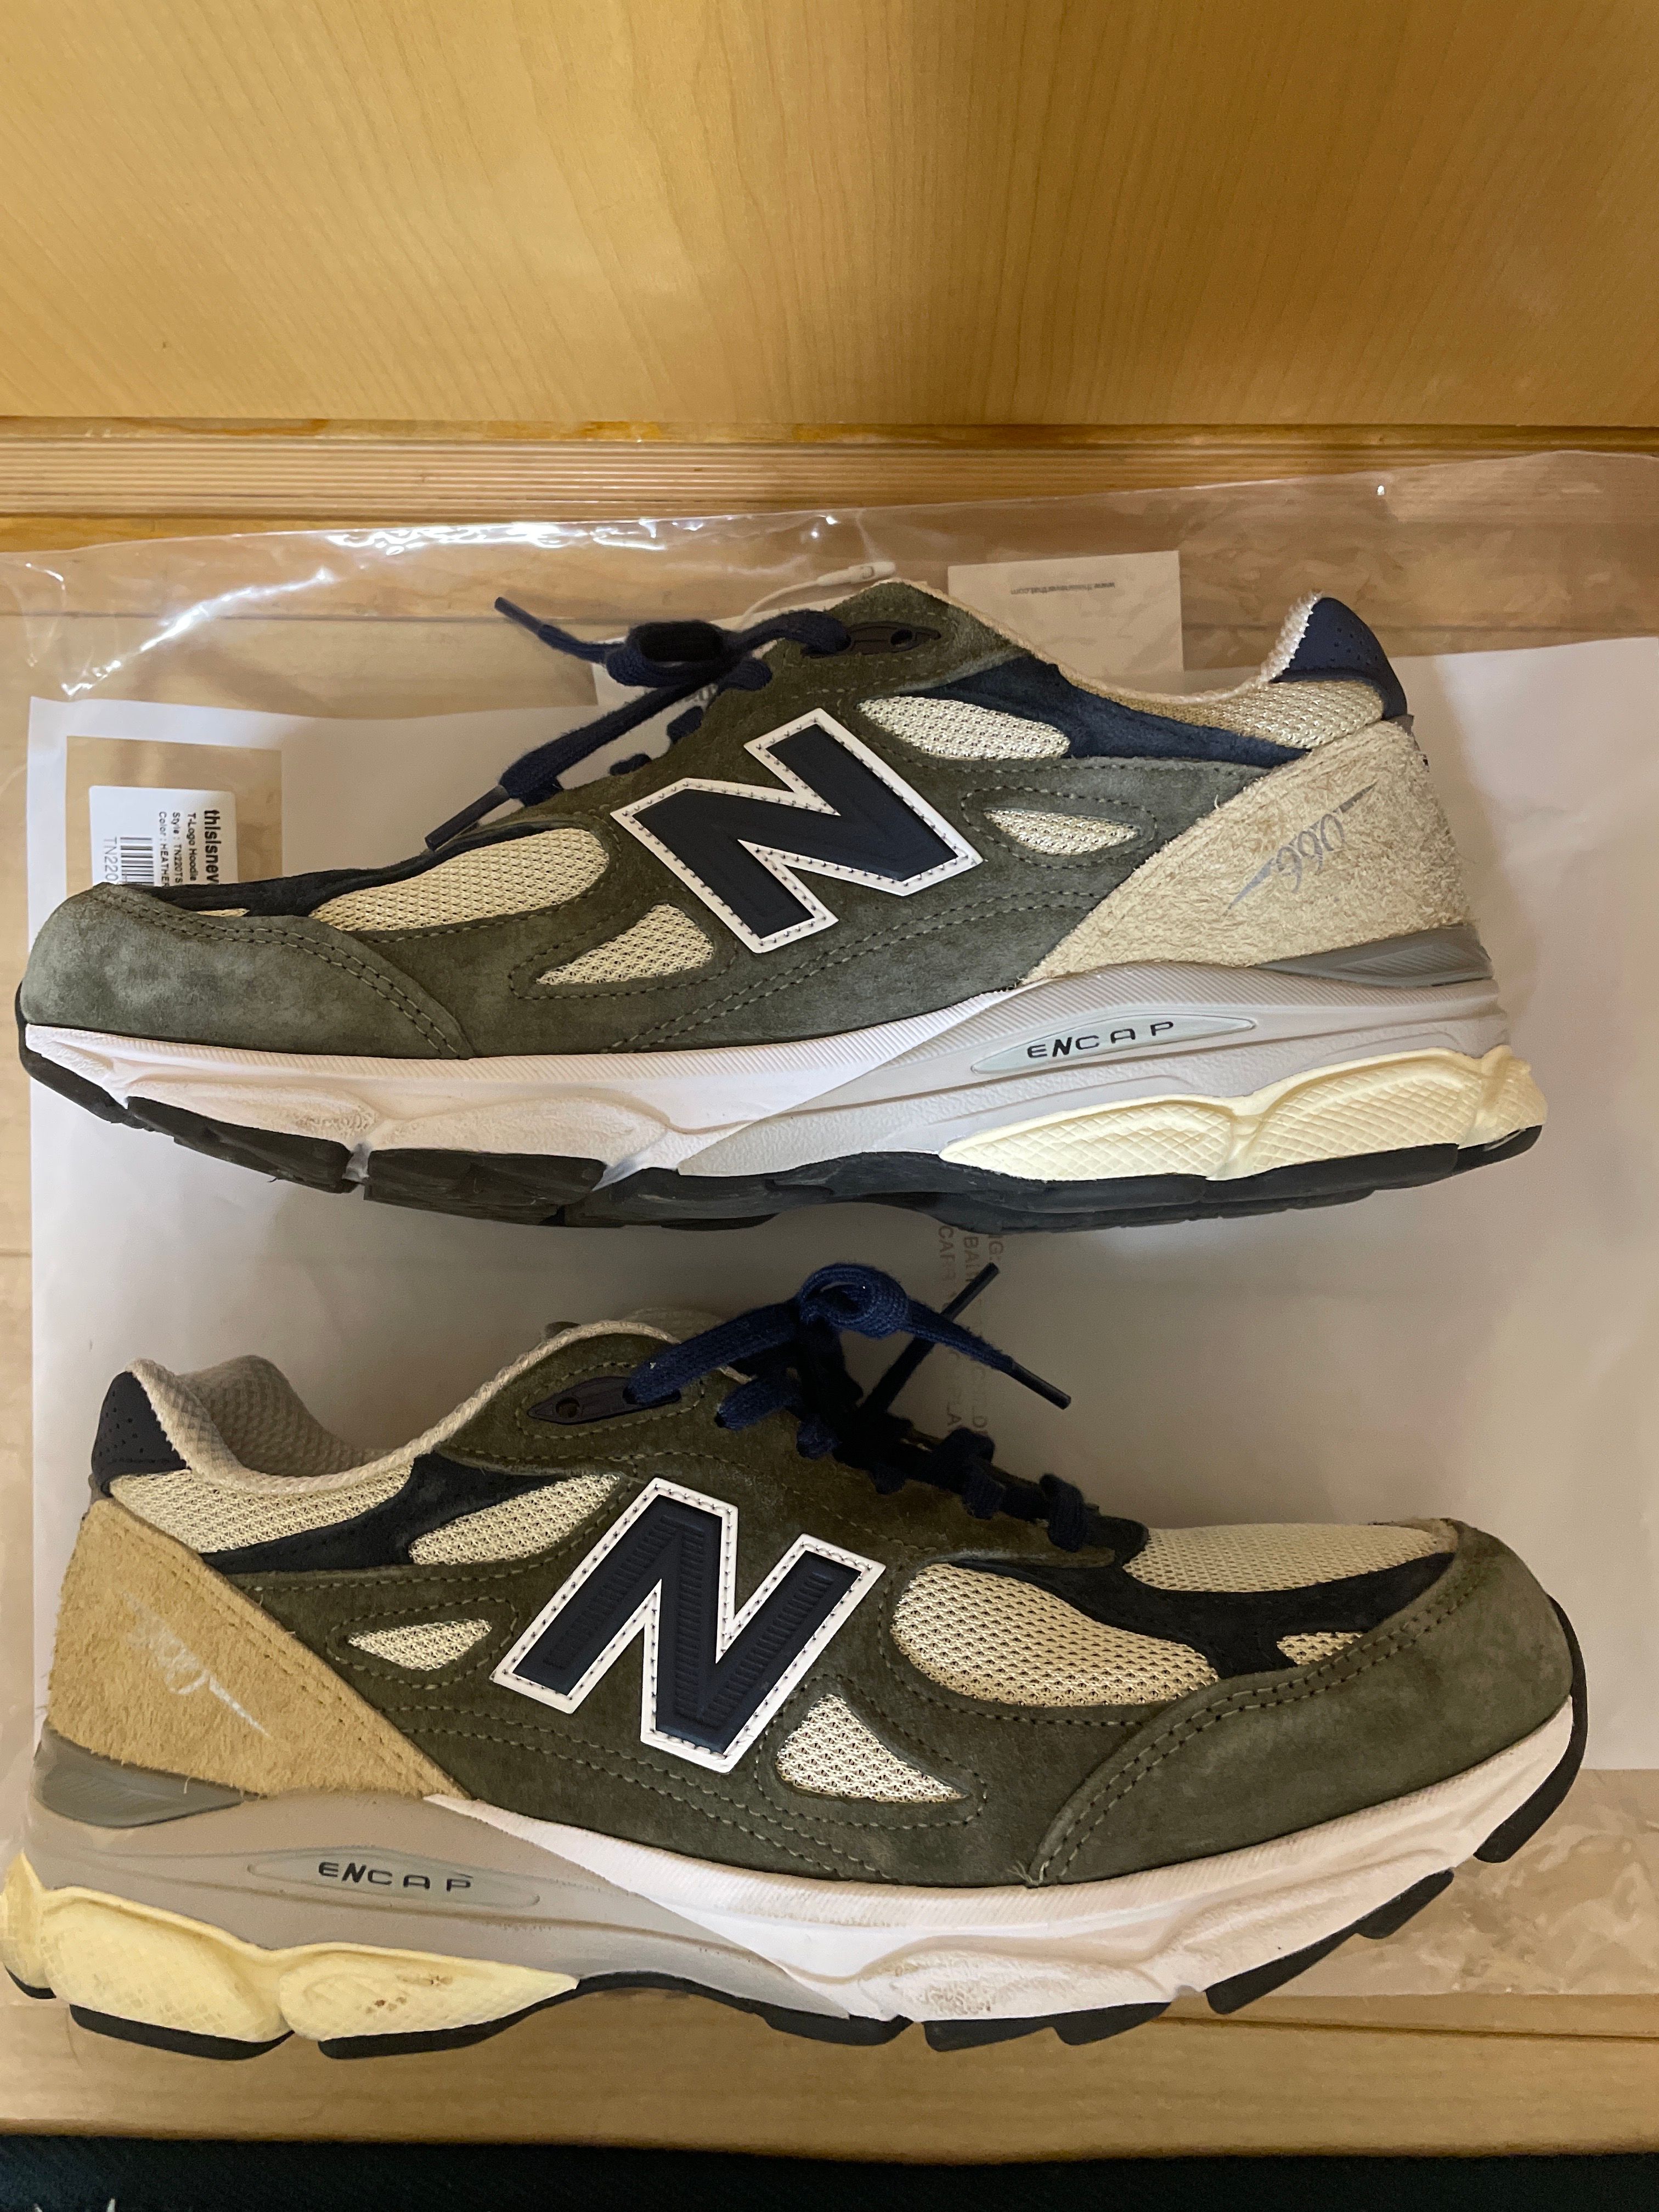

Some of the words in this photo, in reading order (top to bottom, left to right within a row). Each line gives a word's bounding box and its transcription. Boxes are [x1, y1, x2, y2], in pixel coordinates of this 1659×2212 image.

[159, 811, 167, 836] Color
[186, 812, 197, 845] T-Logo
[610, 708, 984, 954] N
[189, 848, 199, 882] Hoodie
[1026, 1021, 1174, 1059] ENCAP
[489, 1477, 886, 1774] N
[318, 1861, 472, 1892] ENCAP
